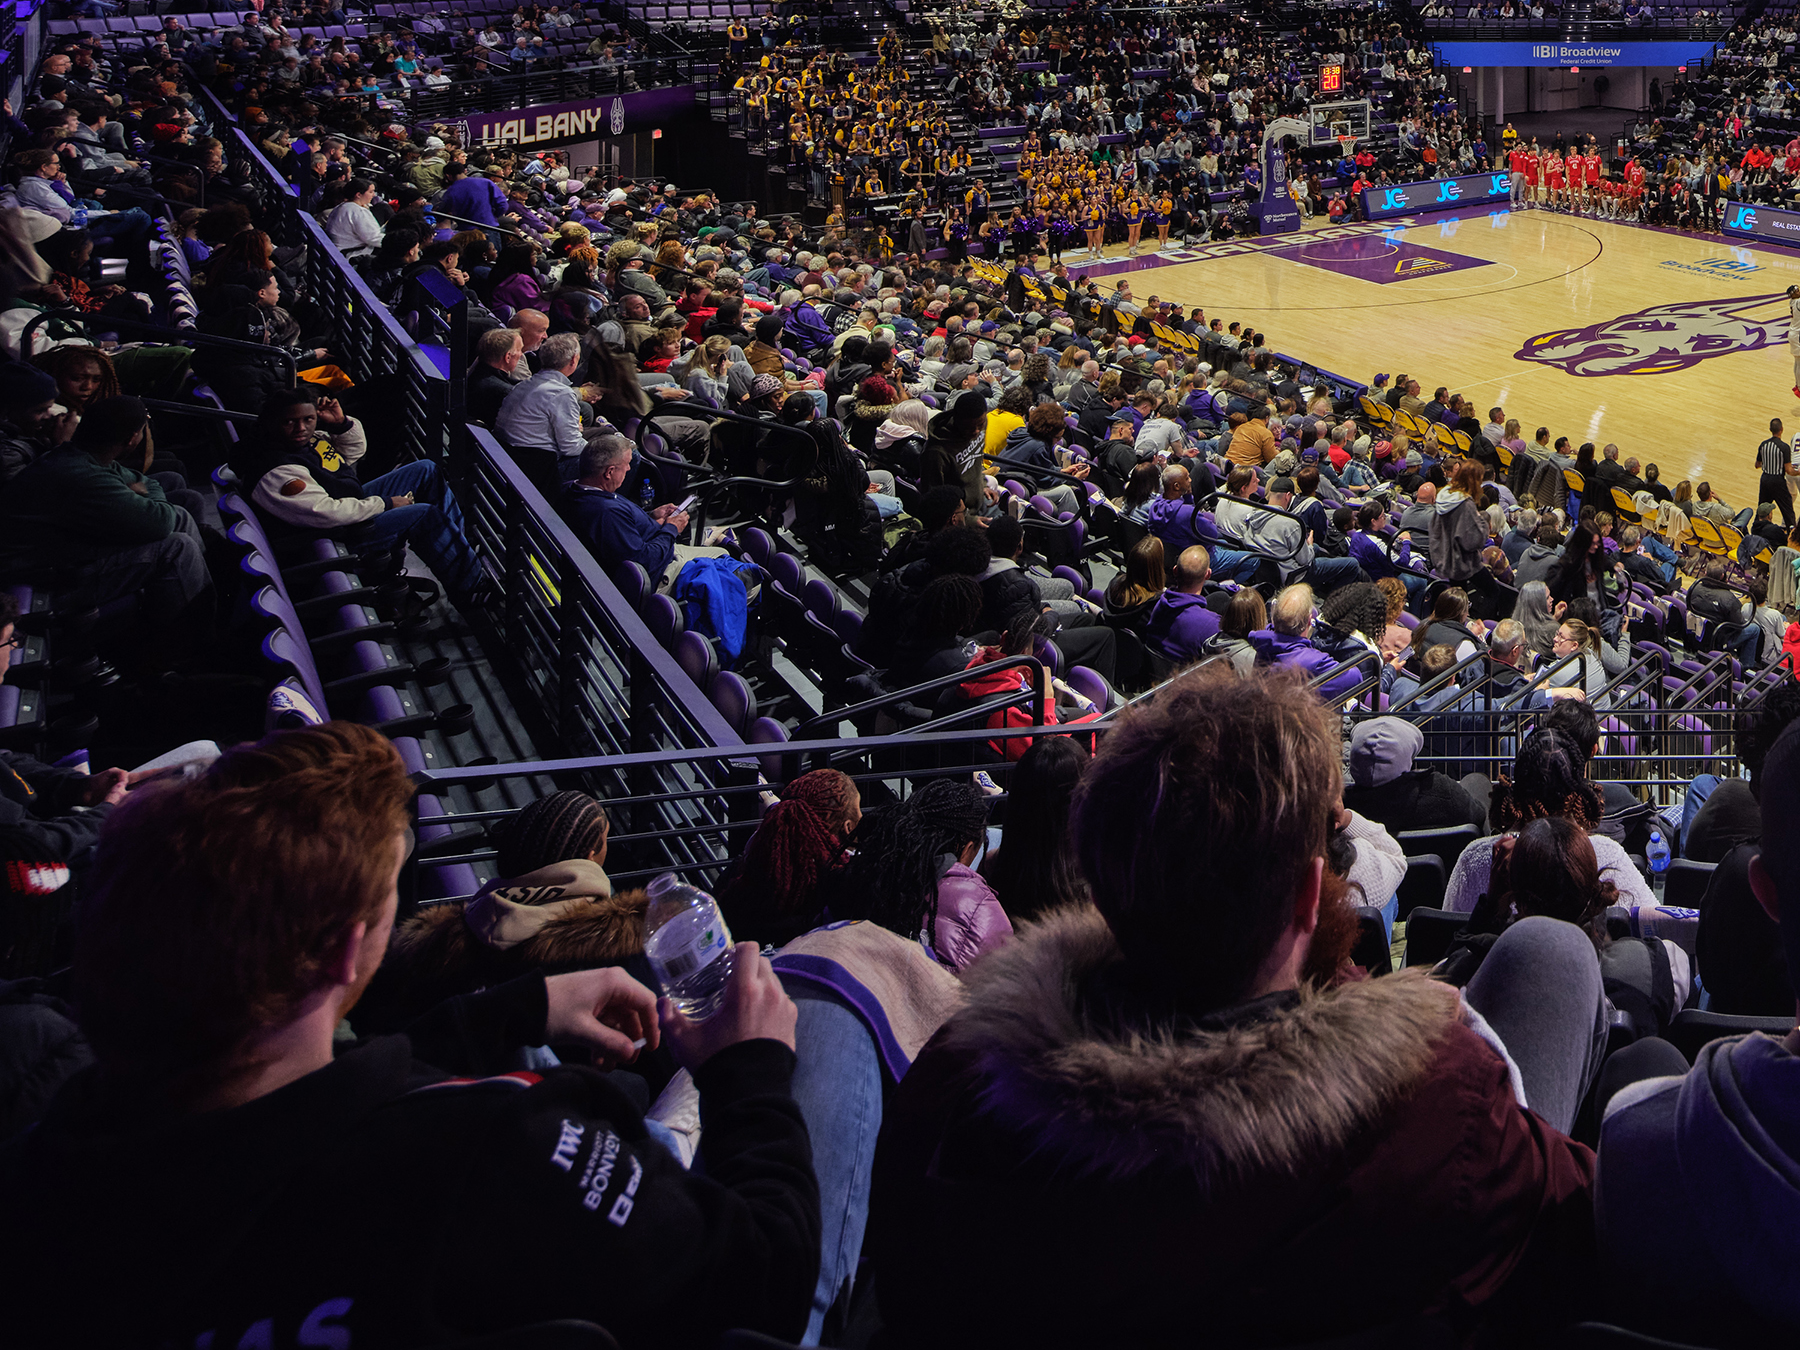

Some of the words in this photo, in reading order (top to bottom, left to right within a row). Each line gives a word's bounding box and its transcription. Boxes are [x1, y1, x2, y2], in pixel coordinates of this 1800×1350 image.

[1560, 46, 1621, 57] Broadview
[1322, 74, 1338, 89] 20
[1323, 66, 1340, 75] 13:38
[482, 107, 602, 148] UALBANY
[1436, 181, 1460, 203] JC
[1488, 174, 1510, 195] JC
[1381, 188, 1406, 210] JC
[1729, 207, 1756, 231] JC
[1772, 221, 1786, 229] REAL
[1660, 260, 1752, 281] Broadview
[550, 1118, 585, 1172] IWC
[579, 1129, 605, 1188] MARRIOTT
[583, 1129, 621, 1211] BONVOY
